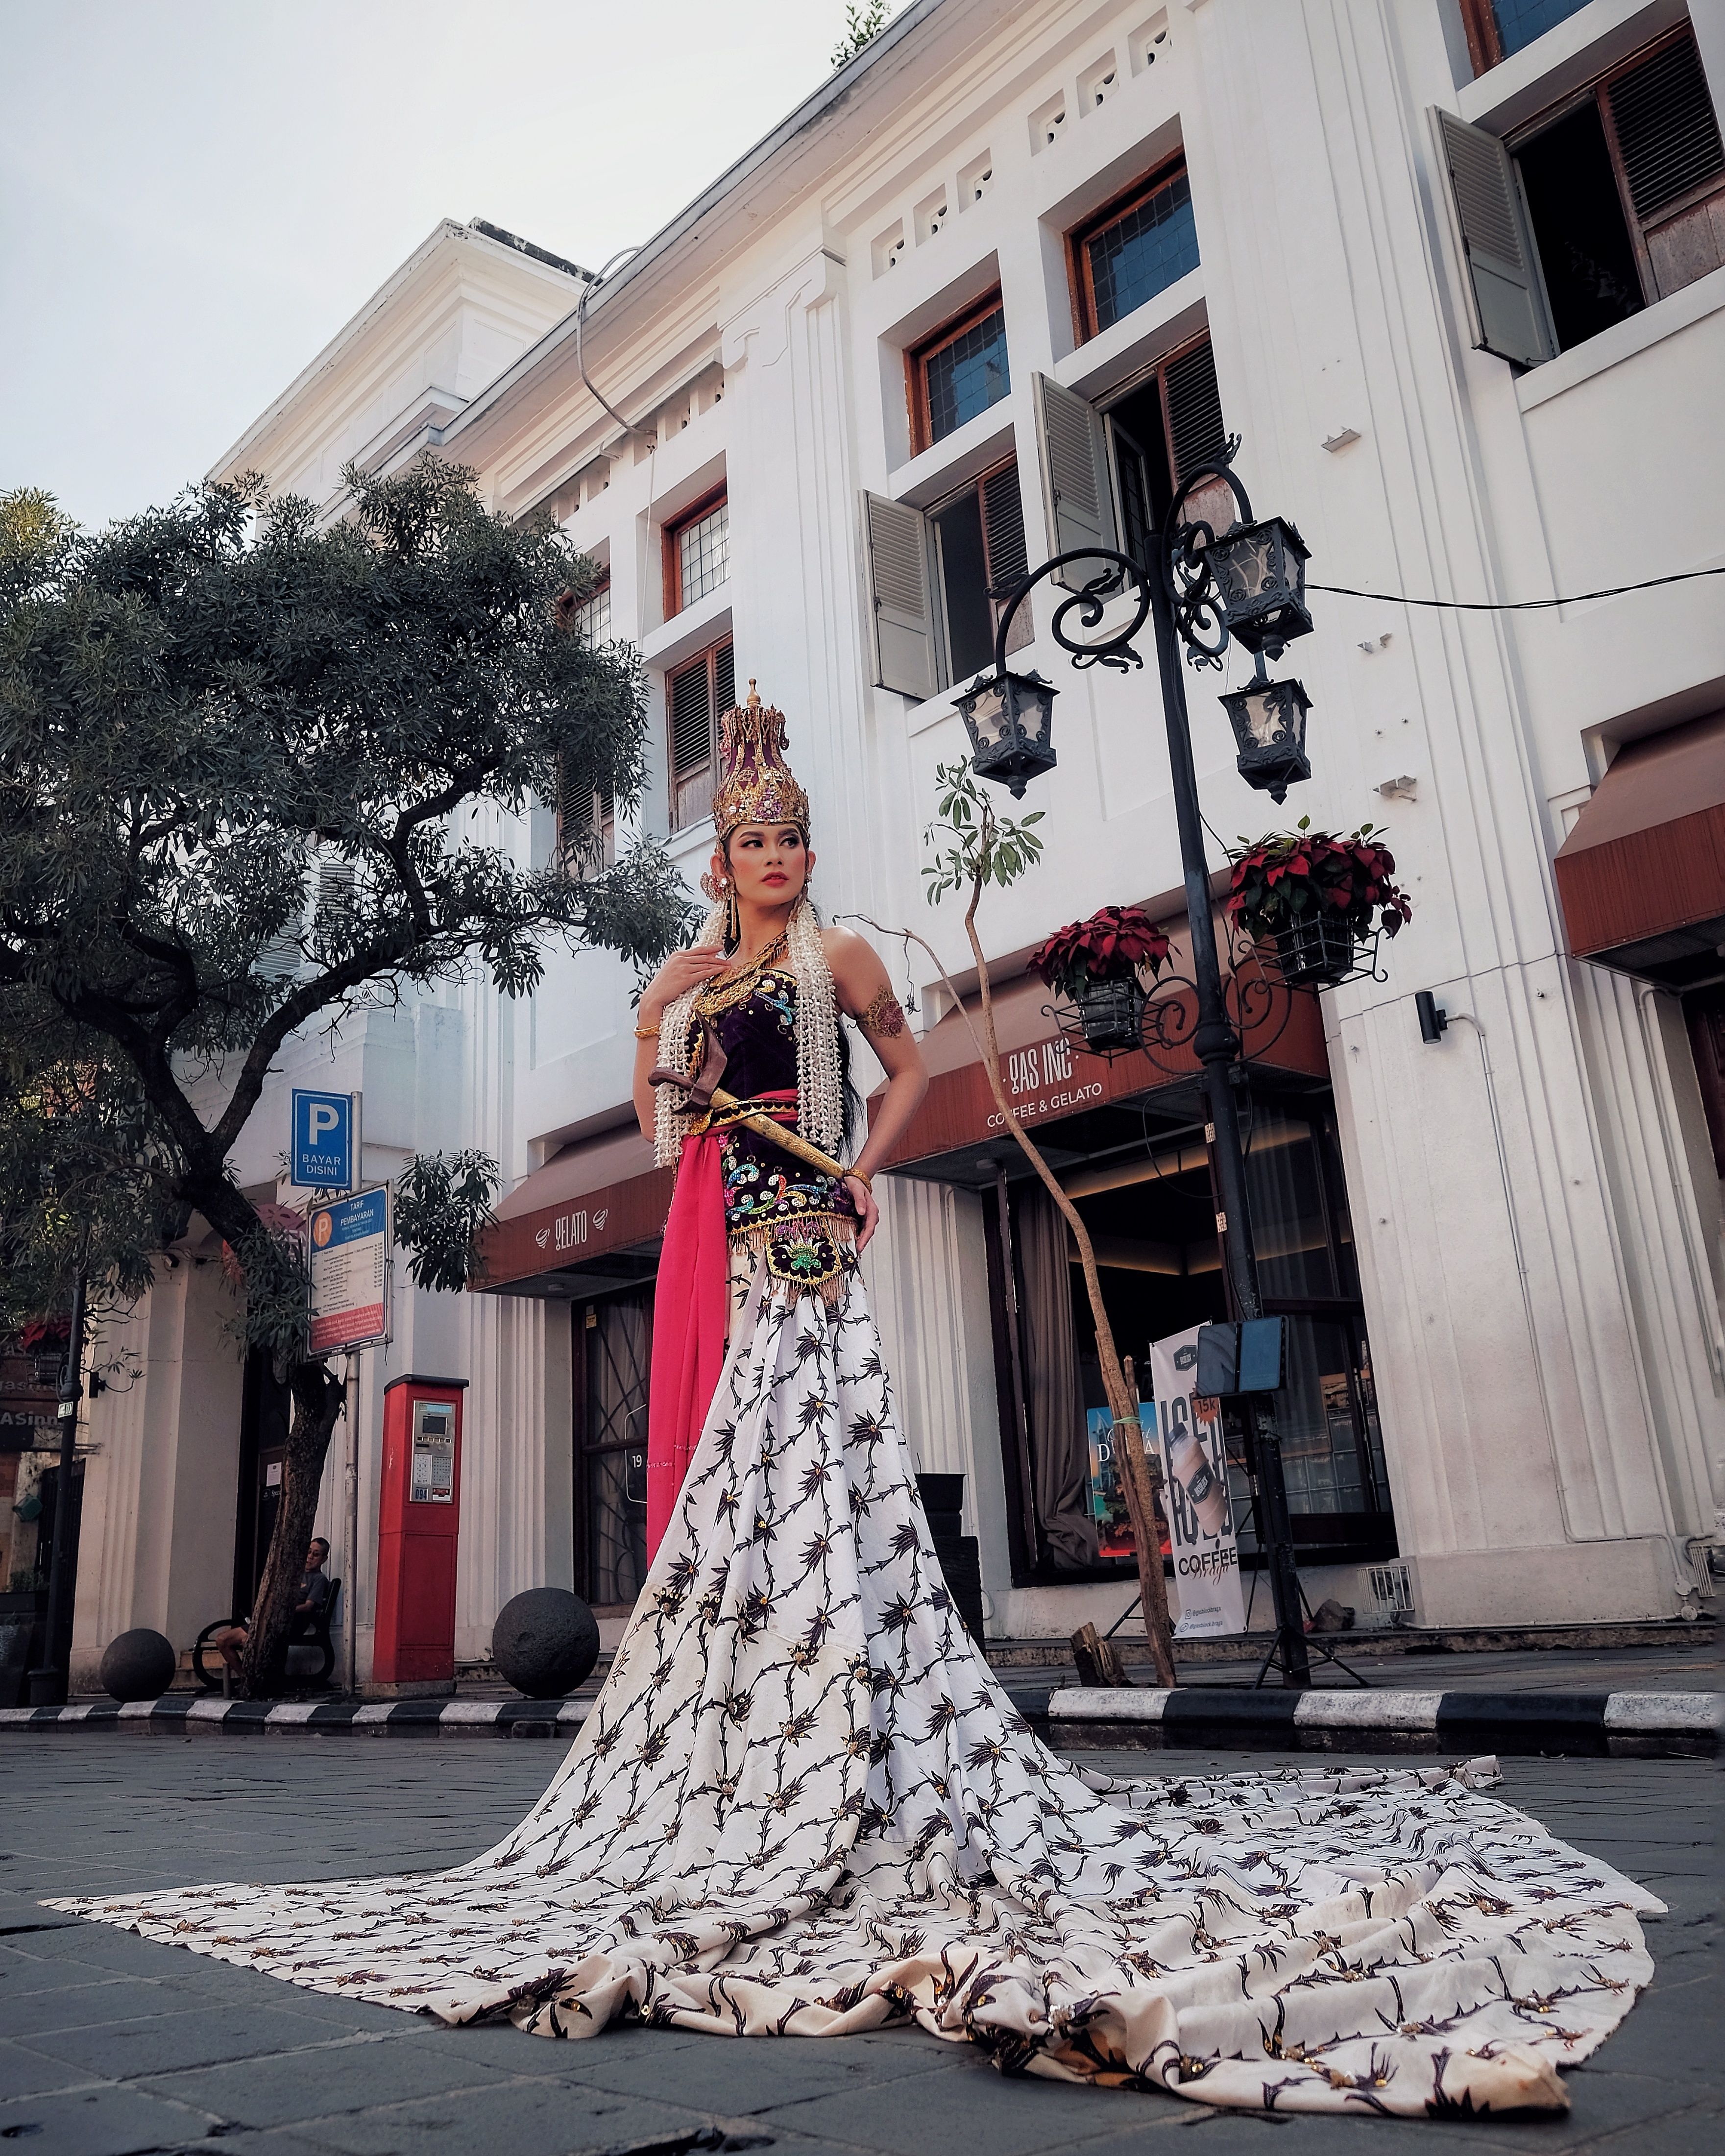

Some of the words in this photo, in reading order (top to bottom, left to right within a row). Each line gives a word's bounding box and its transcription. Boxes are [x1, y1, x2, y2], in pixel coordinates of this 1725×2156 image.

[987, 1102, 1036, 1128] COFEE
[1039, 1100, 1048, 1113] &
[1050, 1083, 1102, 1110] GELATO
[309, 1103, 339, 1145] P
[302, 1154, 341, 1165] BAYAR
[307, 1165, 337, 1176] DISINI
[350, 1200, 364, 1211] TARIF
[340, 1209, 374, 1226] PEMBAYARAN
[318, 1218, 328, 1241] P
[632, 1454, 642, 1468] 19
[415, 1488, 427, 1500] 094
[1178, 1547, 1238, 1576] COFFEE
